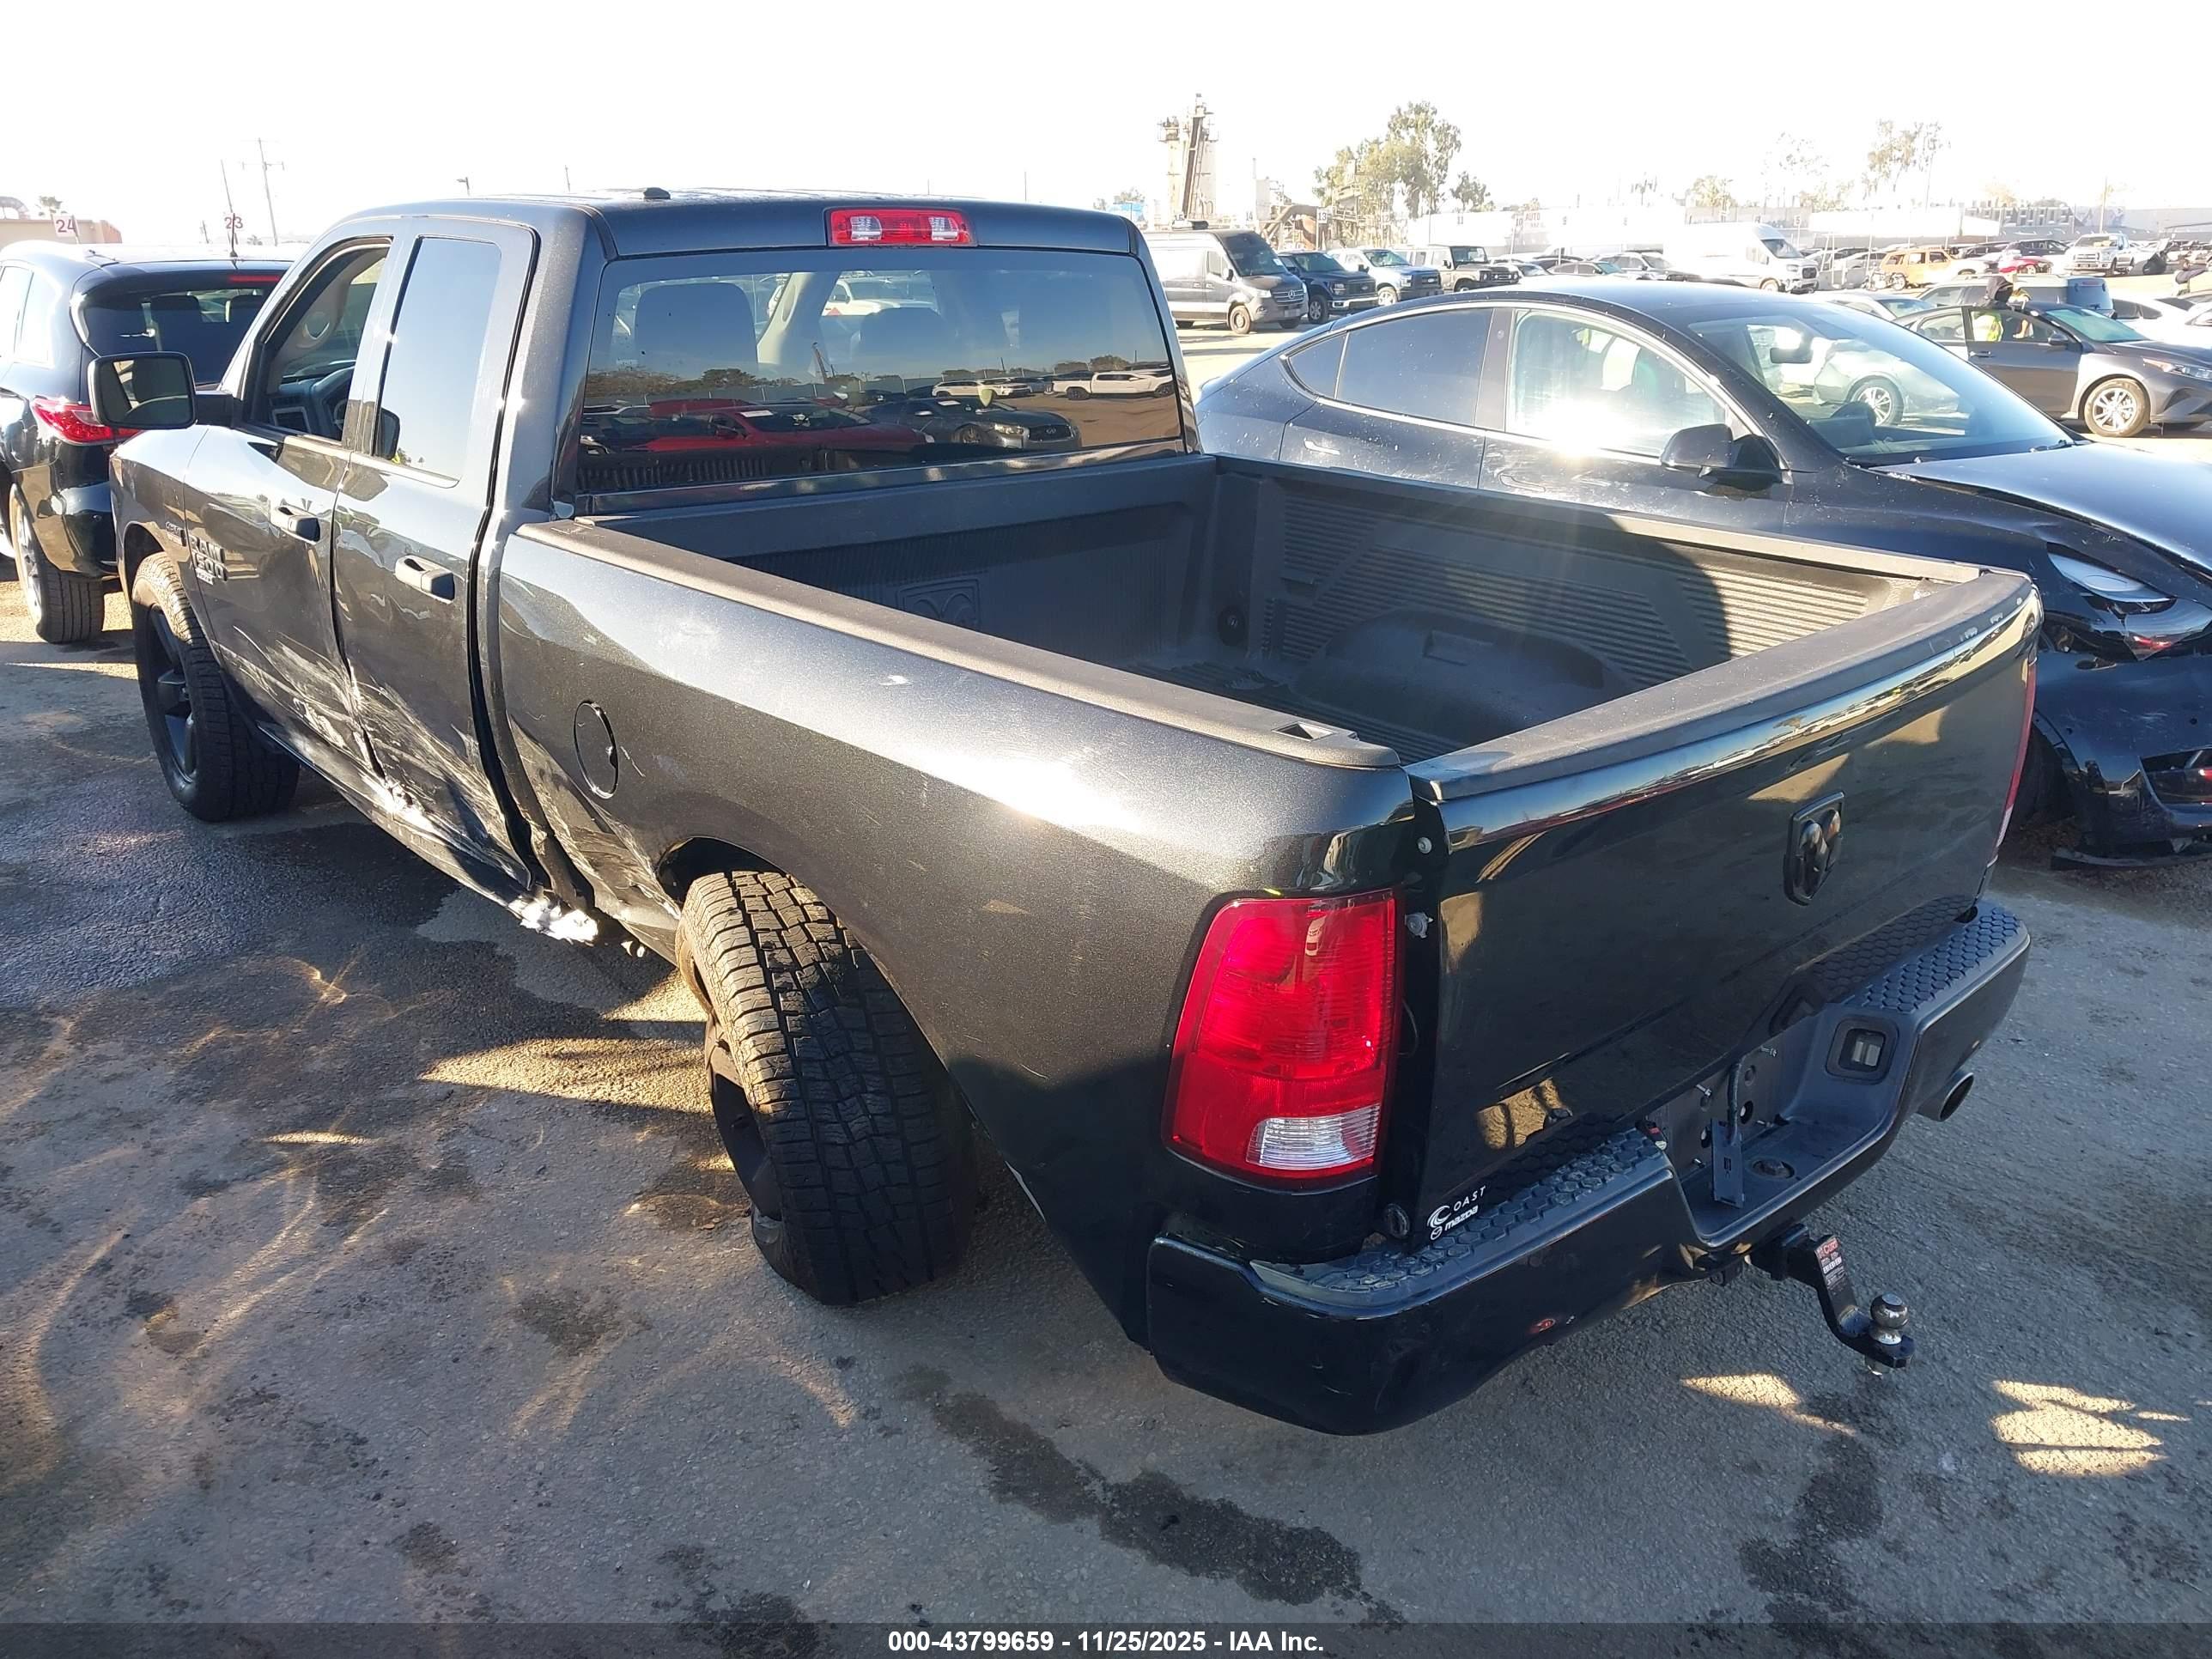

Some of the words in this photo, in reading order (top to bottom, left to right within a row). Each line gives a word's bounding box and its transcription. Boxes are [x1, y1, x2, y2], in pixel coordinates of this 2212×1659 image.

[224, 216, 244, 229] 23
[1317, 212, 1327, 221] 13
[1525, 212, 1540, 221] AUTO
[55, 220, 76, 234] 24
[189, 533, 224, 563] RAM
[191, 549, 228, 580] 1500
[1444, 1205, 1479, 1231] mazda
